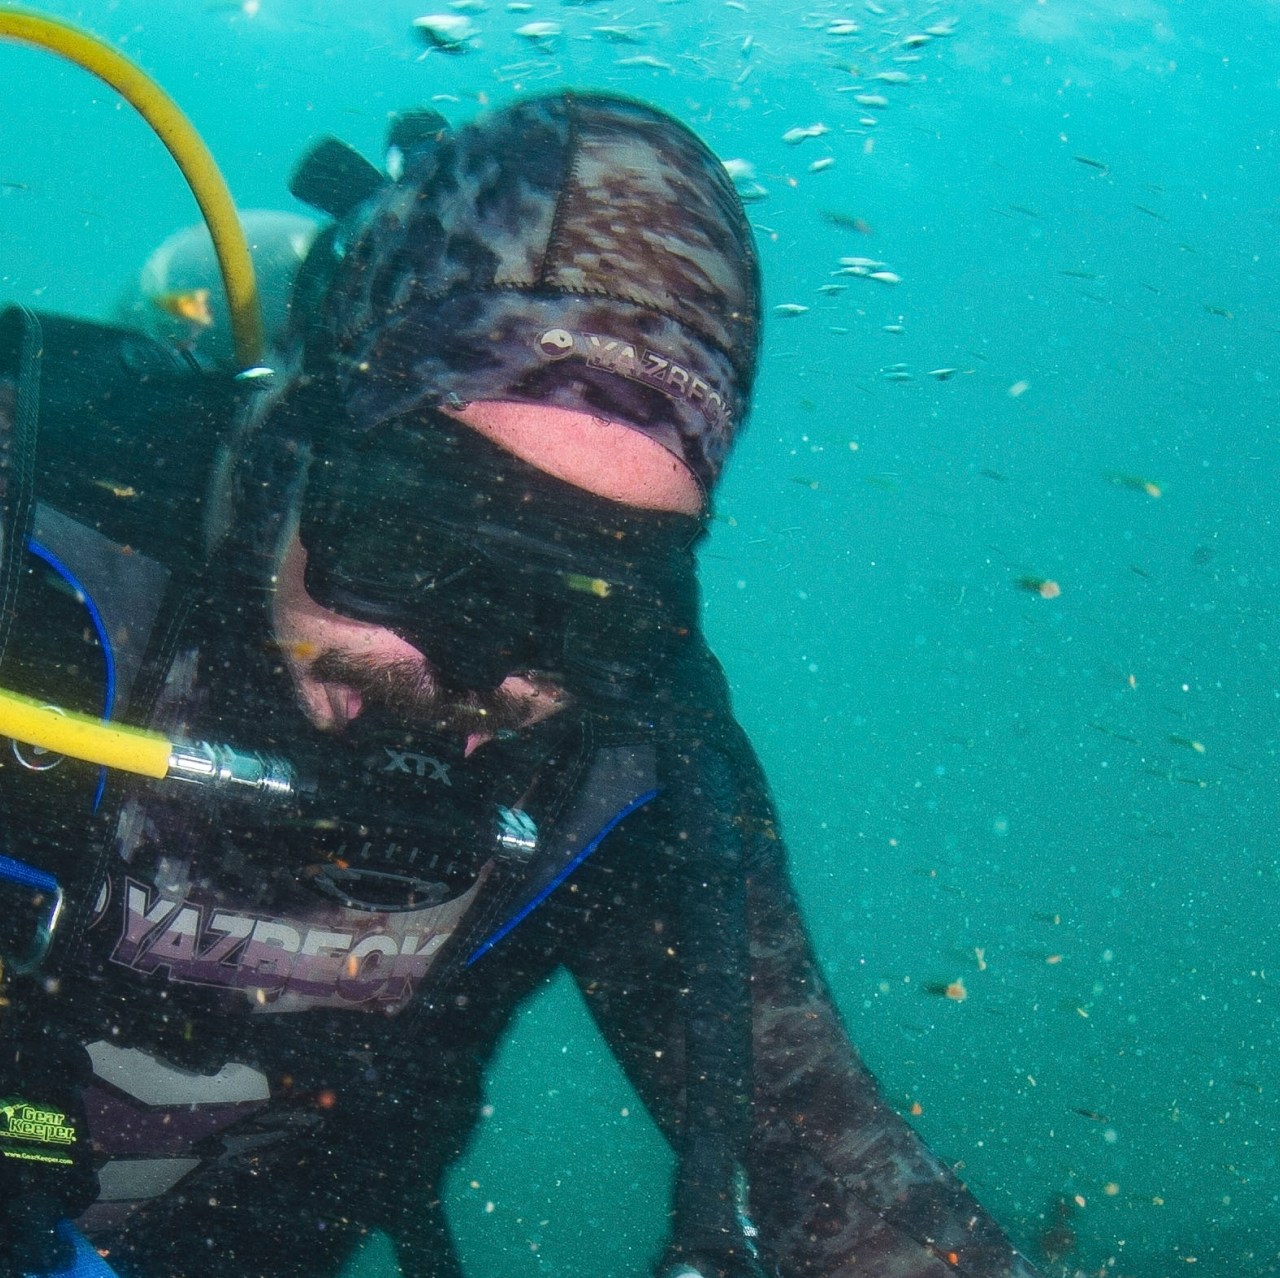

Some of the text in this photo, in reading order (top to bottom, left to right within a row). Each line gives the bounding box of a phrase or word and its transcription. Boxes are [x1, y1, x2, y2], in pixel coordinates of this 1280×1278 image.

[383, 747, 452, 787] XTX
[109, 876, 452, 1003] YAZBECK
[23, 1108, 64, 1125] Gear
[5, 1152, 73, 1164] www.GearKeeper.com
